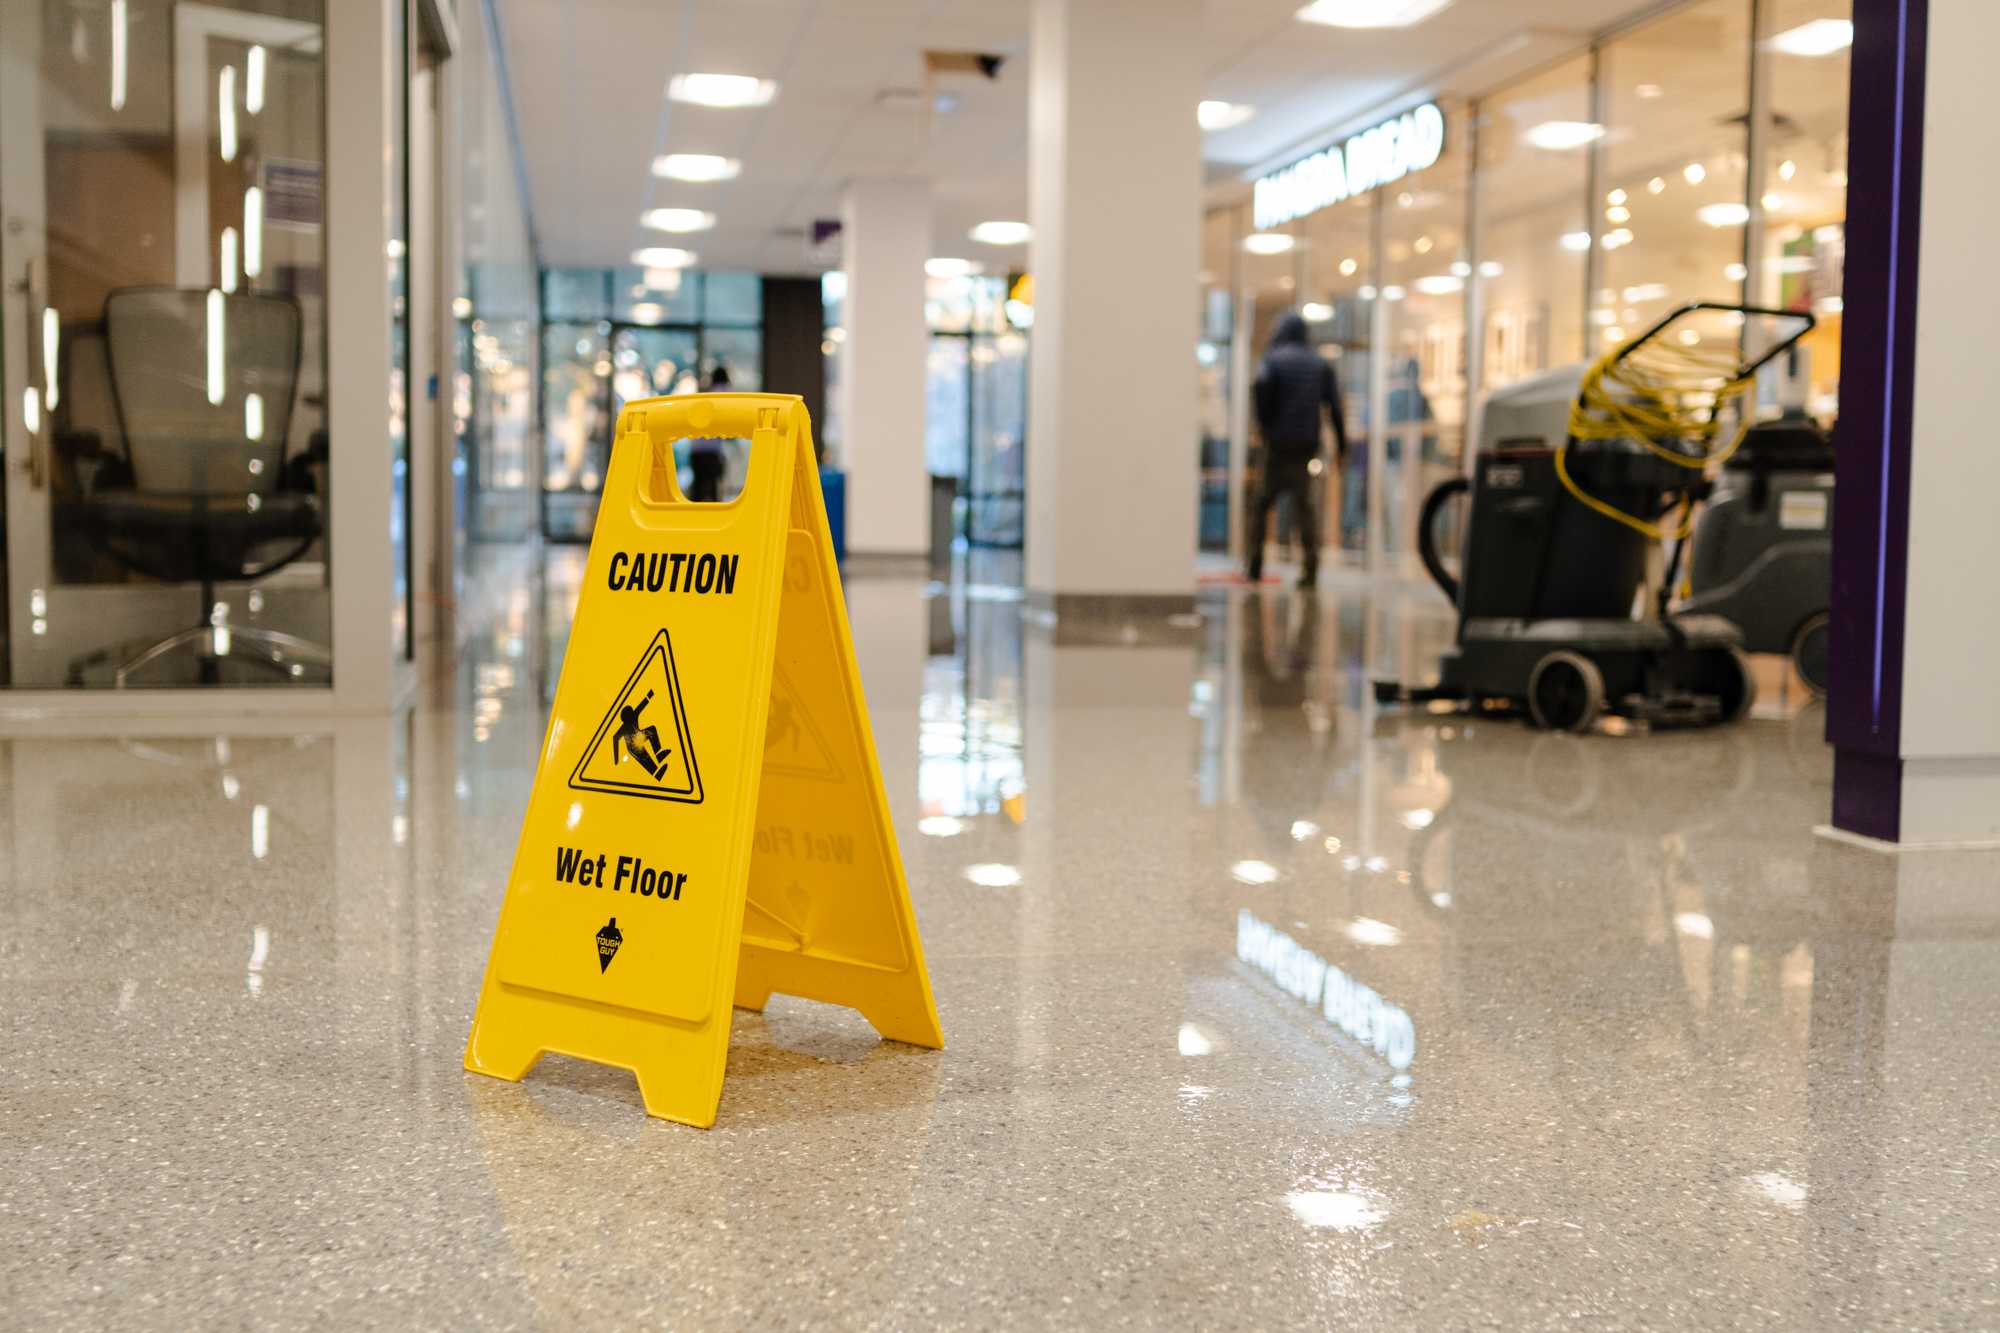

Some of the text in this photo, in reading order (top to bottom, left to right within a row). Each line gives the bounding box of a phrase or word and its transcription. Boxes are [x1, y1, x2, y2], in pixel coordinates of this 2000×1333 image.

[607, 551, 738, 594] CAUTION
[556, 846, 688, 901] Wet Floor
[596, 936, 621, 948] TOUGH
[599, 946, 615, 956] GUY
